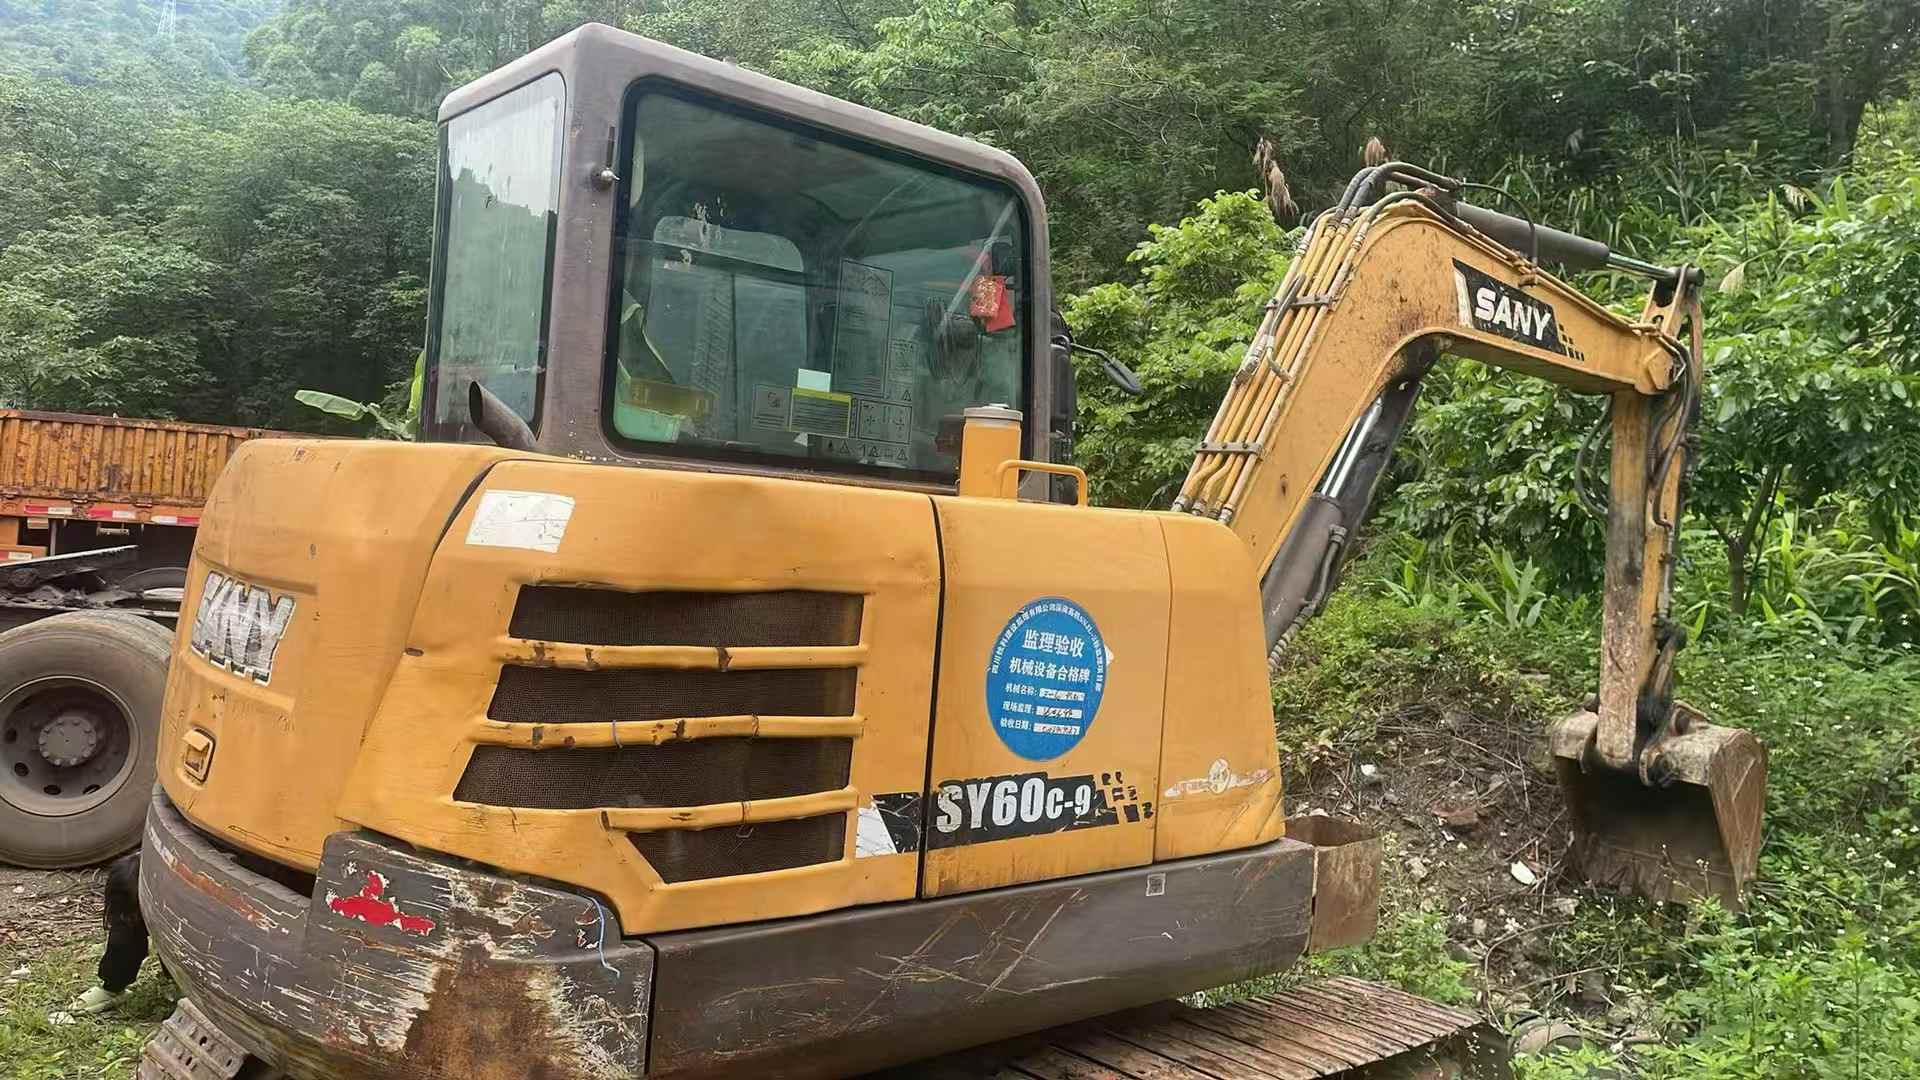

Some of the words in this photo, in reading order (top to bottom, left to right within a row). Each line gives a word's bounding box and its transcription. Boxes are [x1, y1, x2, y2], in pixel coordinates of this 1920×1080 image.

[1475, 287, 1552, 341] SANY
[1022, 629, 1085, 658] 监理验收
[1008, 656, 1091, 684] 机械设备合格牌
